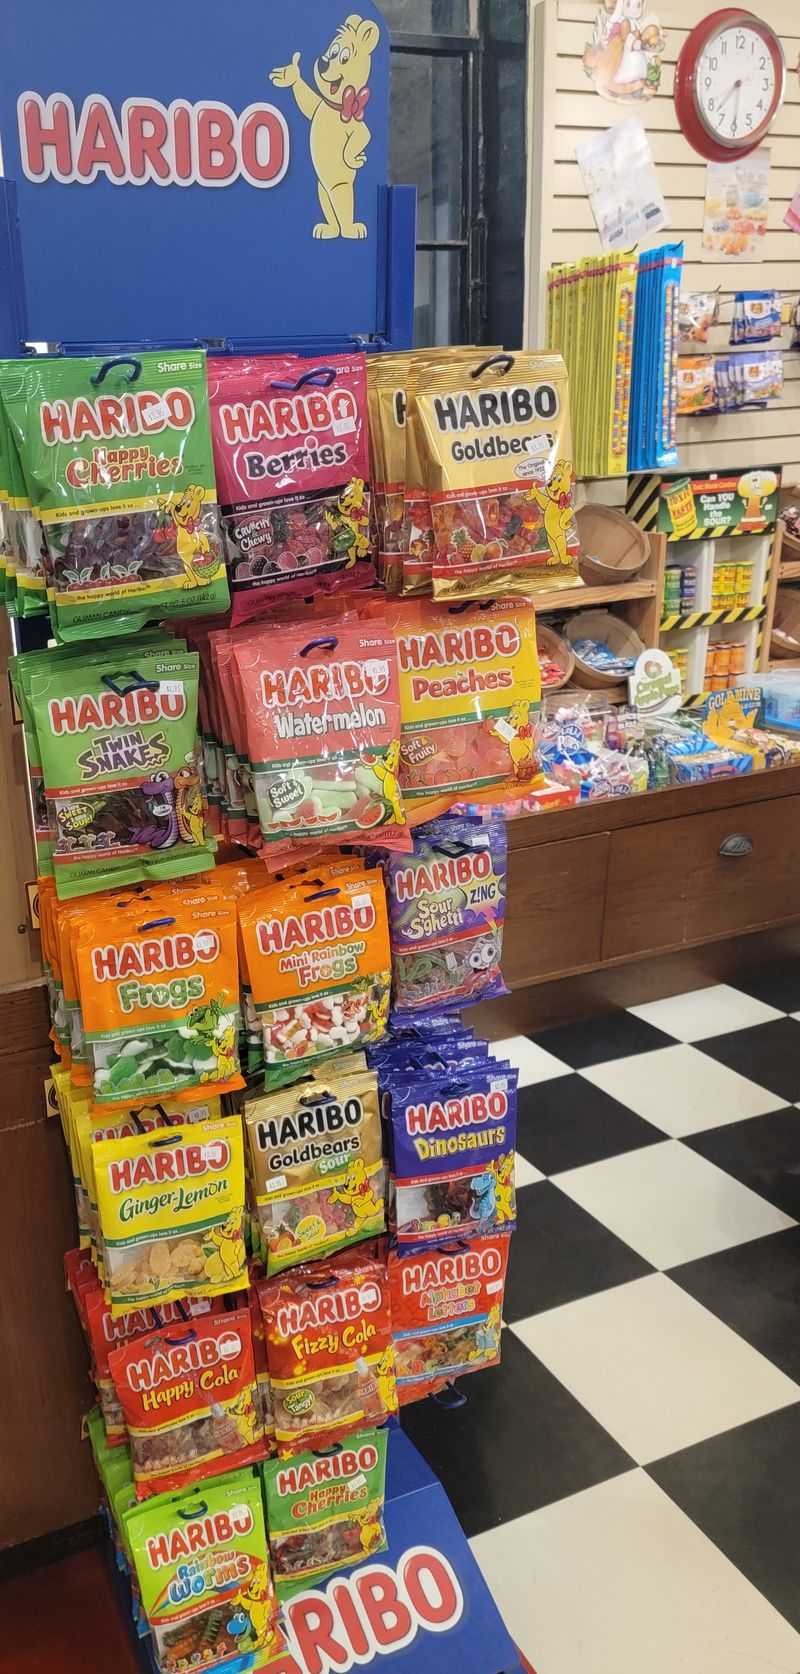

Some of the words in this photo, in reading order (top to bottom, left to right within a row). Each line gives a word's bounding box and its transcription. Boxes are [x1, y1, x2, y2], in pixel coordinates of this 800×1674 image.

[721, 40, 727, 56] 11
[736, 35, 746, 49] 12
[708, 56, 718, 72] 10
[760, 56, 766, 70] 2
[704, 76, 712, 91] 9
[762, 78, 769, 92] 3
[708, 98, 715, 112] 8
[718, 113, 726, 126] 7
[746, 113, 753, 127] 5
[756, 99, 763, 110] 4
[19, 94, 288, 186] HARIBO
[157, 361, 187, 373] Share
[41, 388, 195, 446] HARIBO
[219, 389, 357, 445] HARIBO
[433, 384, 558, 432] HARIBO
[66, 455, 183, 489] Cherries
[92, 446, 150, 466] Happy
[244, 436, 348, 479] Berries
[700, 494, 717, 504] Can
[718, 492, 736, 502] YOU
[234, 519, 271, 539] CRUNCHY
[240, 532, 272, 552] Chewy
[359, 639, 383, 648] Share
[397, 622, 520, 672] HARIBO
[156, 663, 182, 672] Share
[412, 668, 514, 703] Peaches
[49, 690, 187, 736] HARIBO
[274, 702, 387, 738] Watermelon
[77, 732, 171, 780] SNAKES
[94, 731, 144, 751] TWIN
[400, 739, 422, 755] Soft
[408, 743, 437, 765] Fruity
[270, 780, 292, 798] Soft
[395, 851, 493, 903] HARIBO
[417, 897, 453, 919] Sour
[256, 903, 376, 956] HARIBO
[92, 929, 220, 982] HARIBO
[280, 951, 308, 972] Mini
[312, 941, 365, 963] Rainbow
[298, 955, 357, 988] Frogs
[118, 975, 205, 1013] Frogs
[256, 1098, 362, 1150] HARIBO
[406, 1091, 508, 1136] HARIBO
[270, 1136, 360, 1170] Goldbears
[414, 1126, 506, 1160] Dinosaurs
[109, 1140, 231, 1194] HARIBO
[318, 1154, 350, 1174] Sour
[119, 1179, 228, 1222] Ginger-Lemon
[402, 1248, 501, 1296] HARIBO
[292, 1333, 339, 1360] Fizzy
[342, 1318, 376, 1347] Cola
[142, 1379, 194, 1411] Happy
[200, 1363, 239, 1391] Cola
[287, 1391, 305, 1404] Sour
[276, 1444, 378, 1496] HARIBO
[291, 1487, 368, 1520] Cherries
[309, 1483, 348, 1502] Happy
[262, 1546, 463, 1674] RIBO
